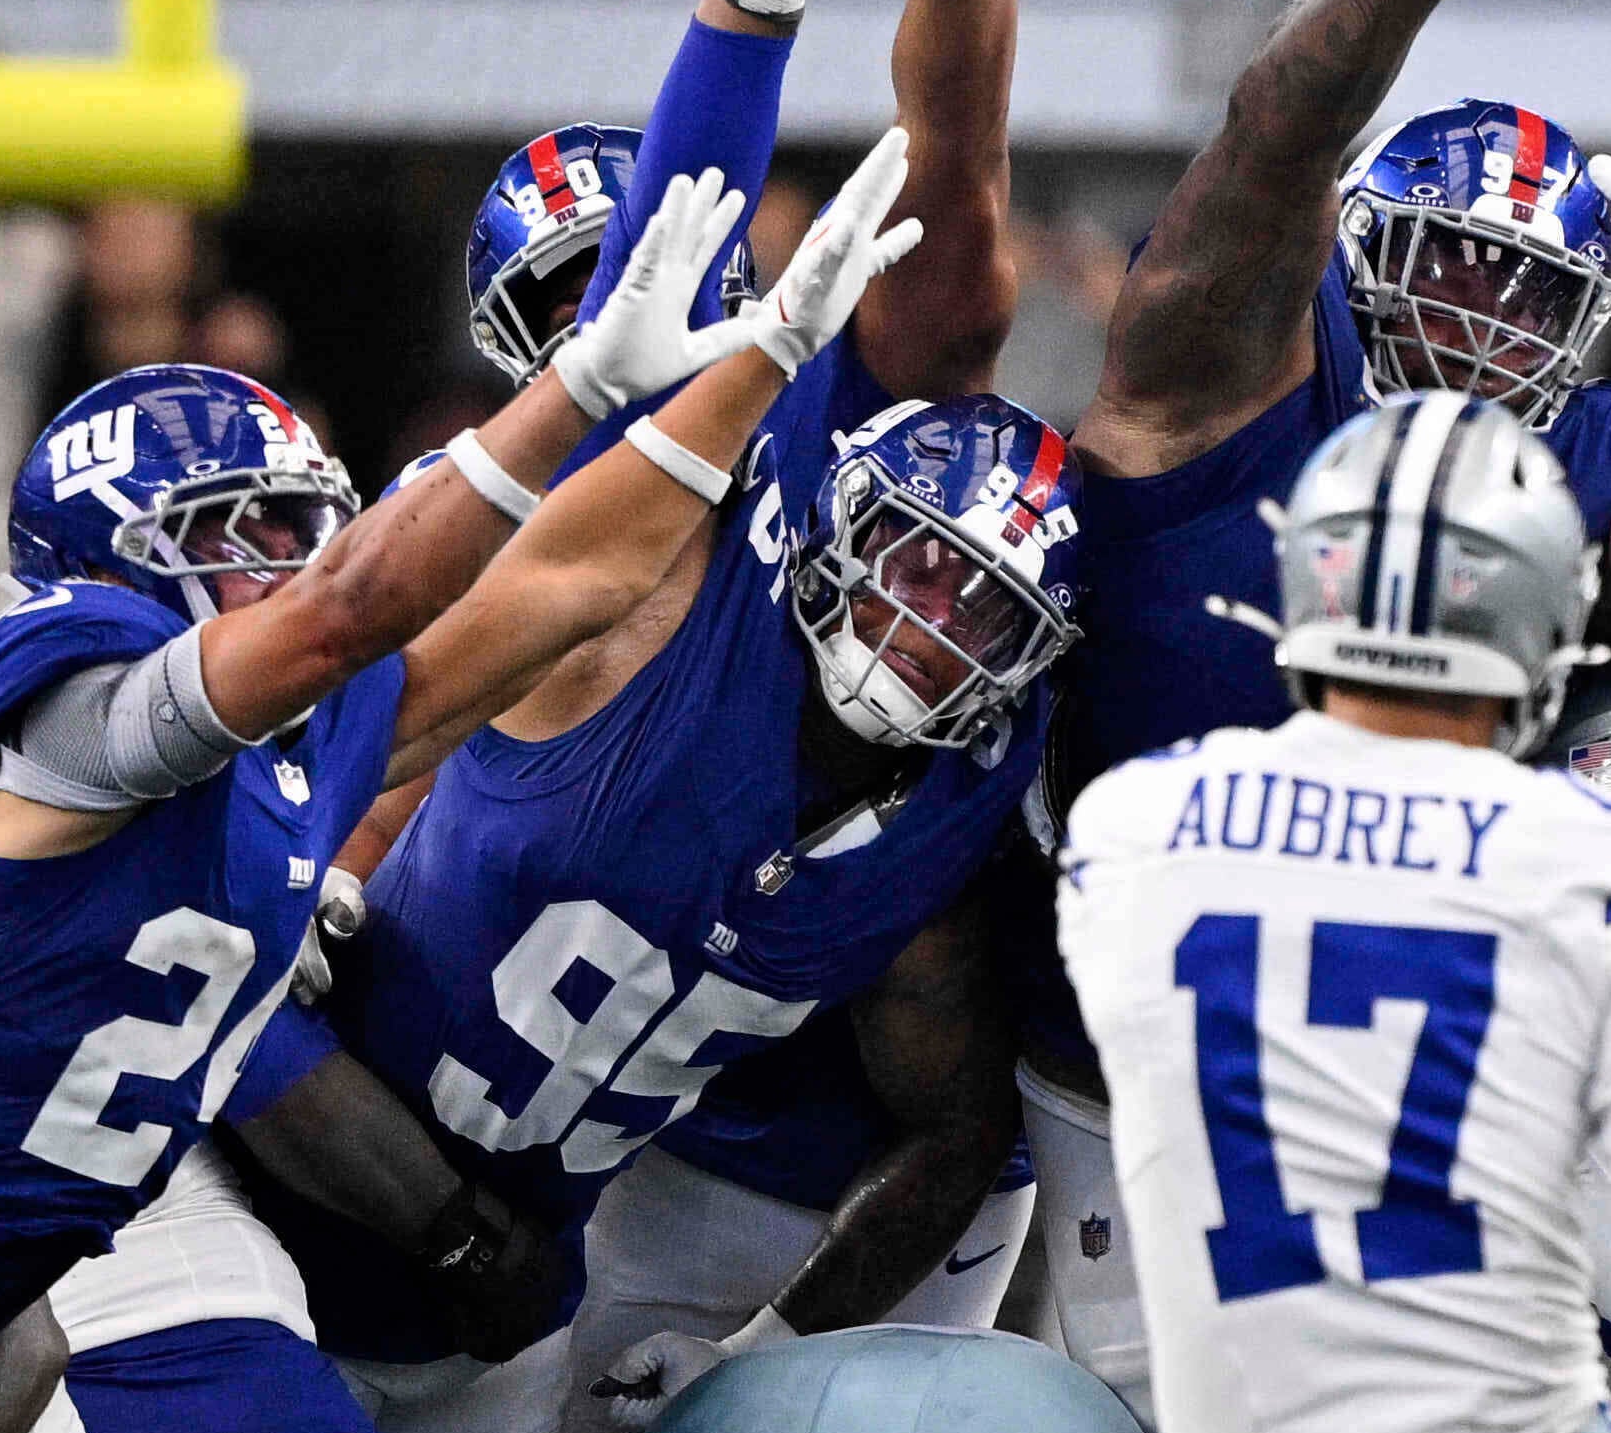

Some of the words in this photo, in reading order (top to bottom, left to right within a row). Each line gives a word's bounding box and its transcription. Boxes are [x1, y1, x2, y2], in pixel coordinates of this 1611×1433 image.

[899, 480, 942, 507] OAKLEY
[977, 461, 1080, 549] 95
[1167, 771, 1511, 878] AUBREY
[427, 898, 820, 1174] 95
[1172, 912, 1499, 1304] 17
